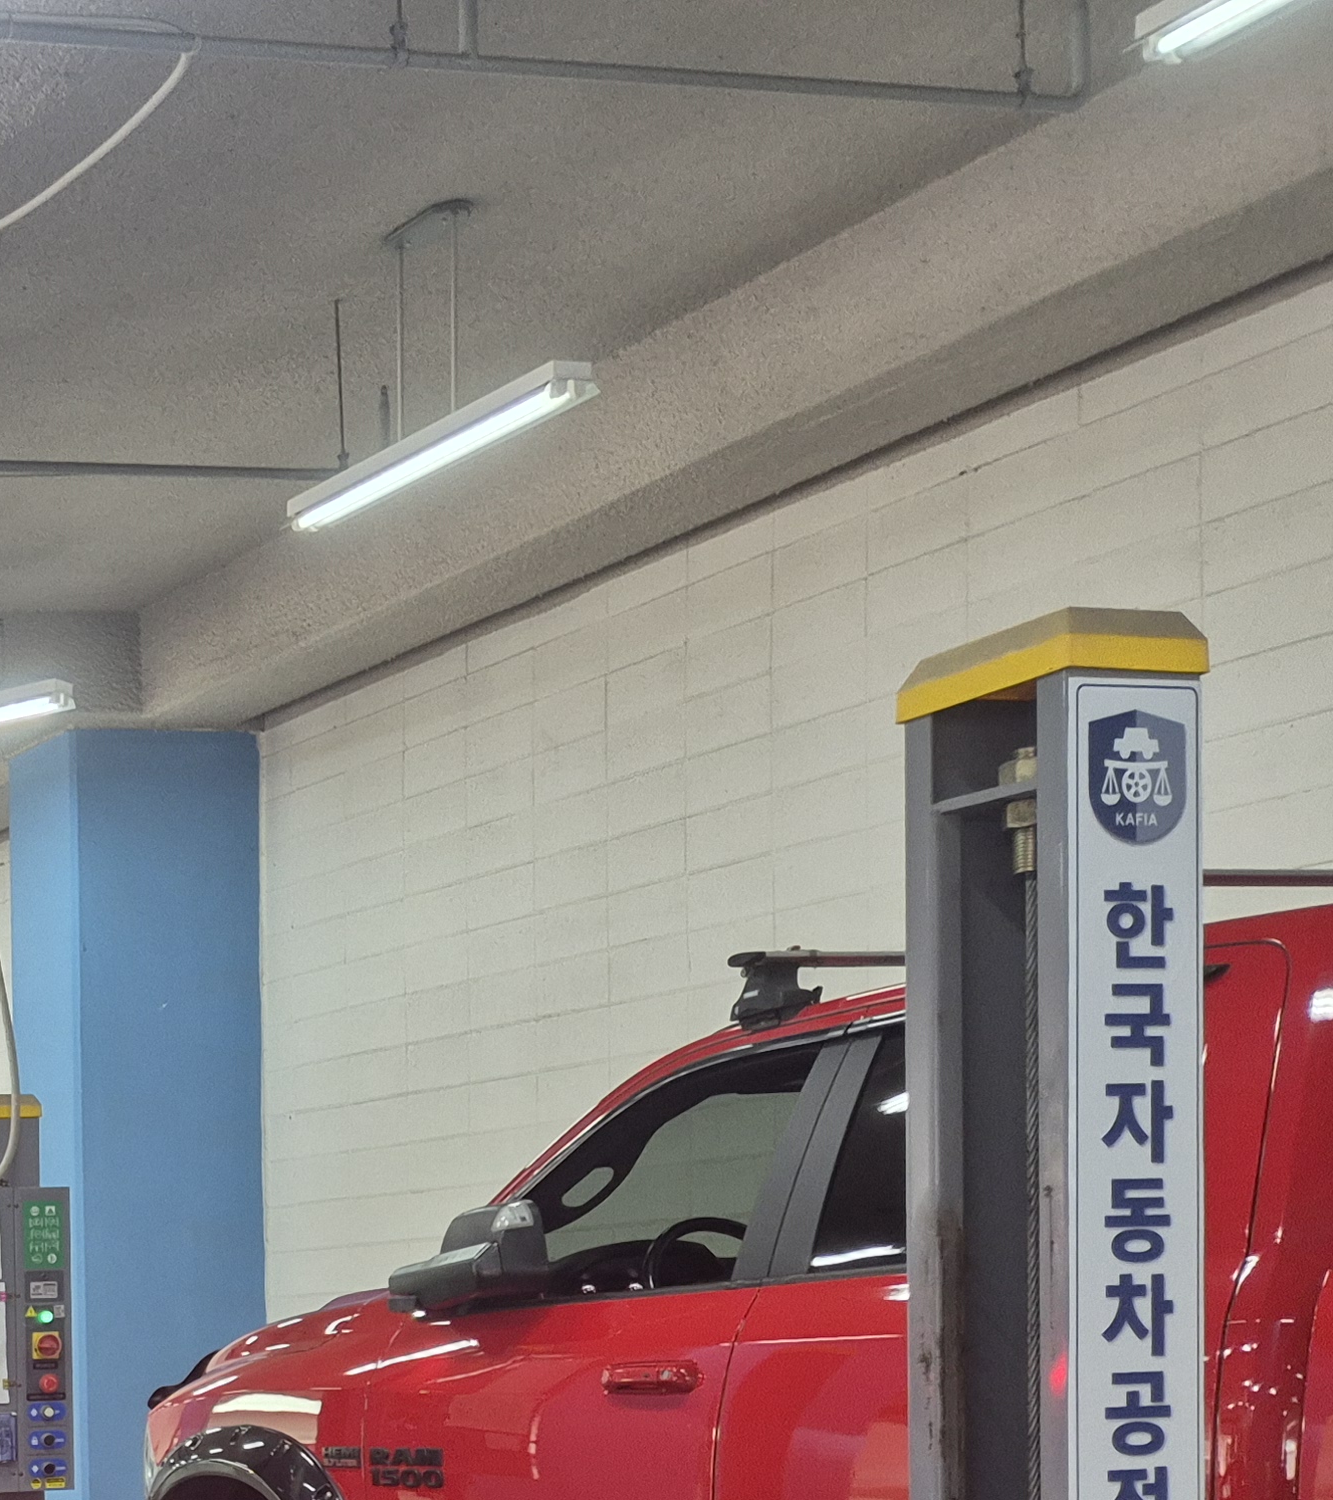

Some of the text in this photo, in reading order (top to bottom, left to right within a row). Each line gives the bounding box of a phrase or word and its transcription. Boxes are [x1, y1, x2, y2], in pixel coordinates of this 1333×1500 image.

[1115, 811, 1158, 827] KAFIA
[369, 1448, 443, 1466] RAM
[371, 1469, 444, 1488] 1500
